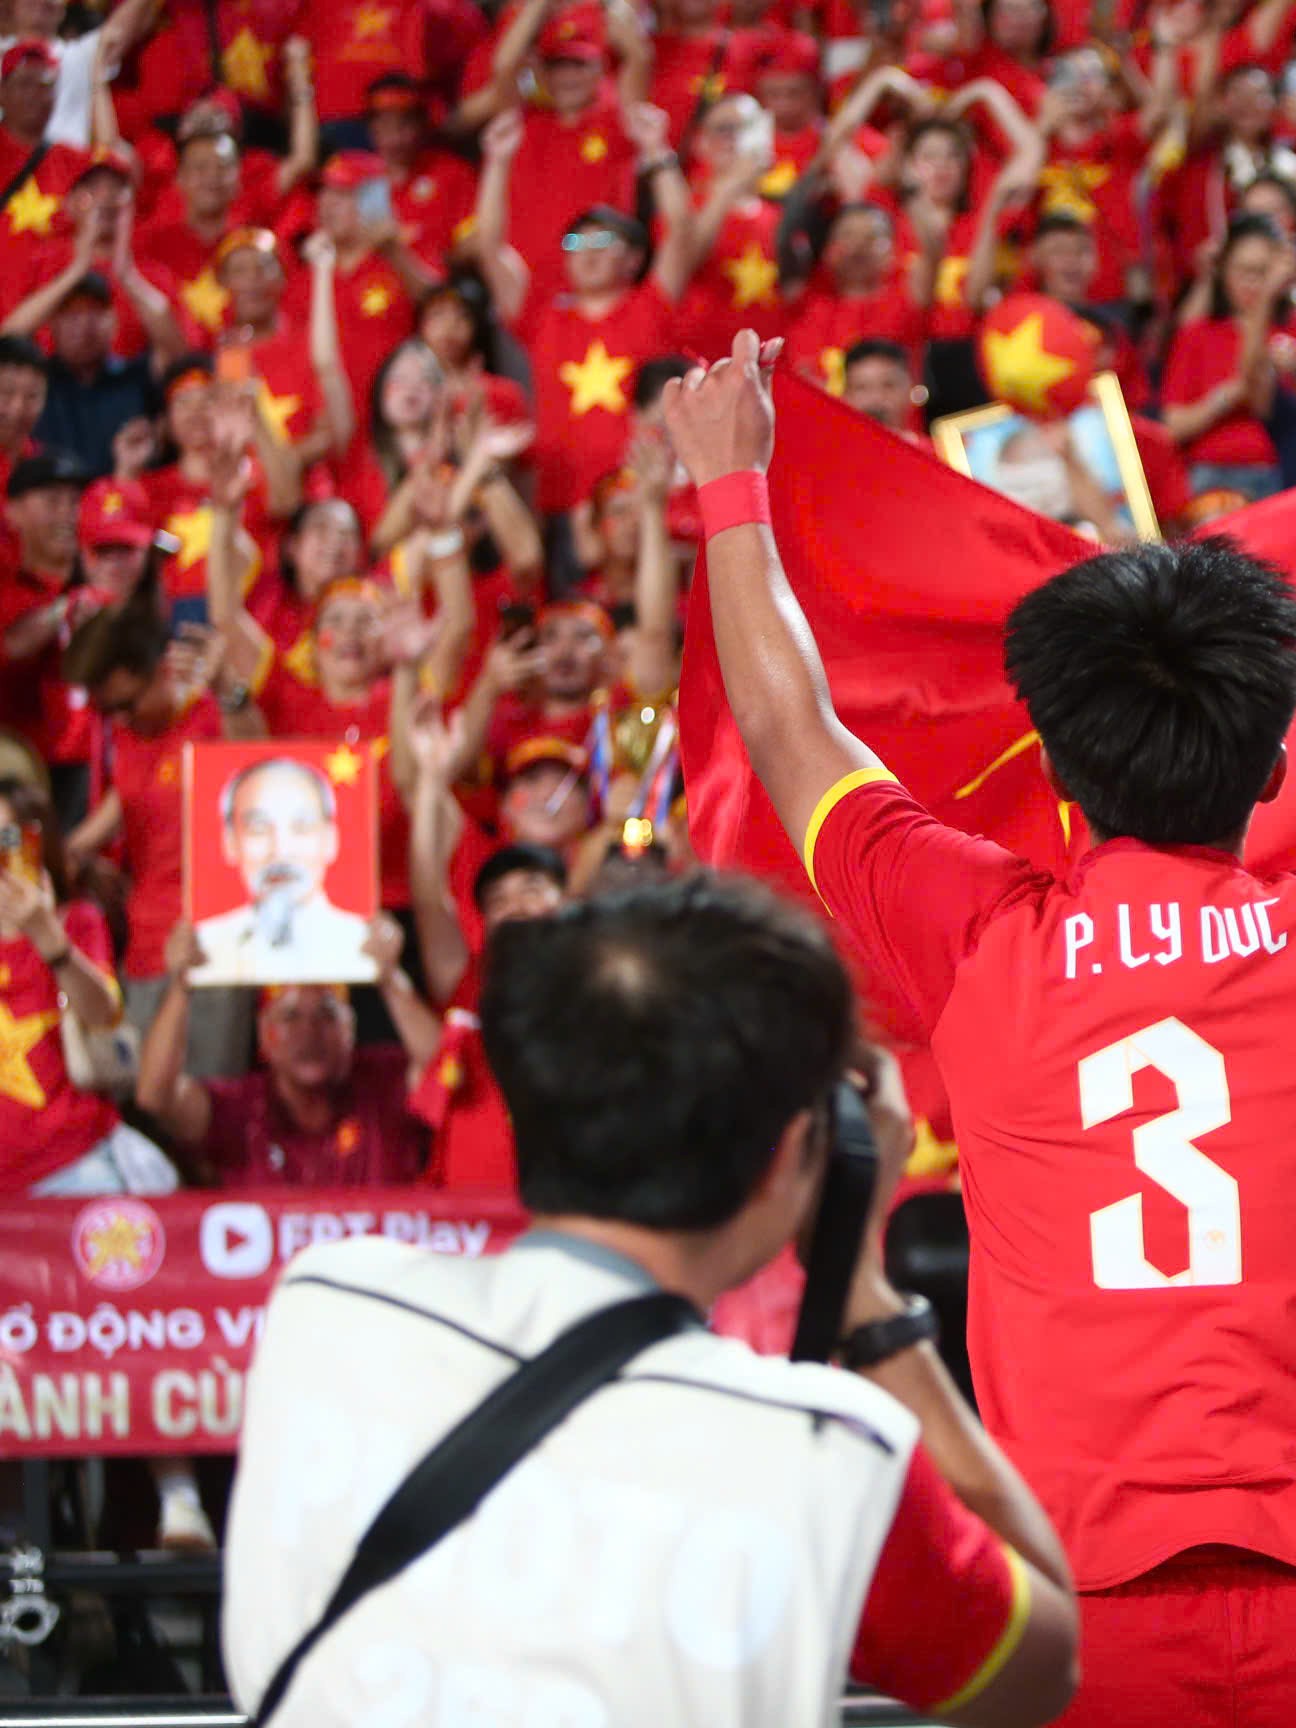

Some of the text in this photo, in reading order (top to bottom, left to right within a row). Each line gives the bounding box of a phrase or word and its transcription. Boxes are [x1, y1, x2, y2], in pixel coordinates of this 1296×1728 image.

[1064, 896, 1288, 980] P. LY DUC
[1077, 1015, 1242, 1290] 3
[382, 1209, 491, 1259] Play
[46, 1302, 205, 1358] ĐỘNG
